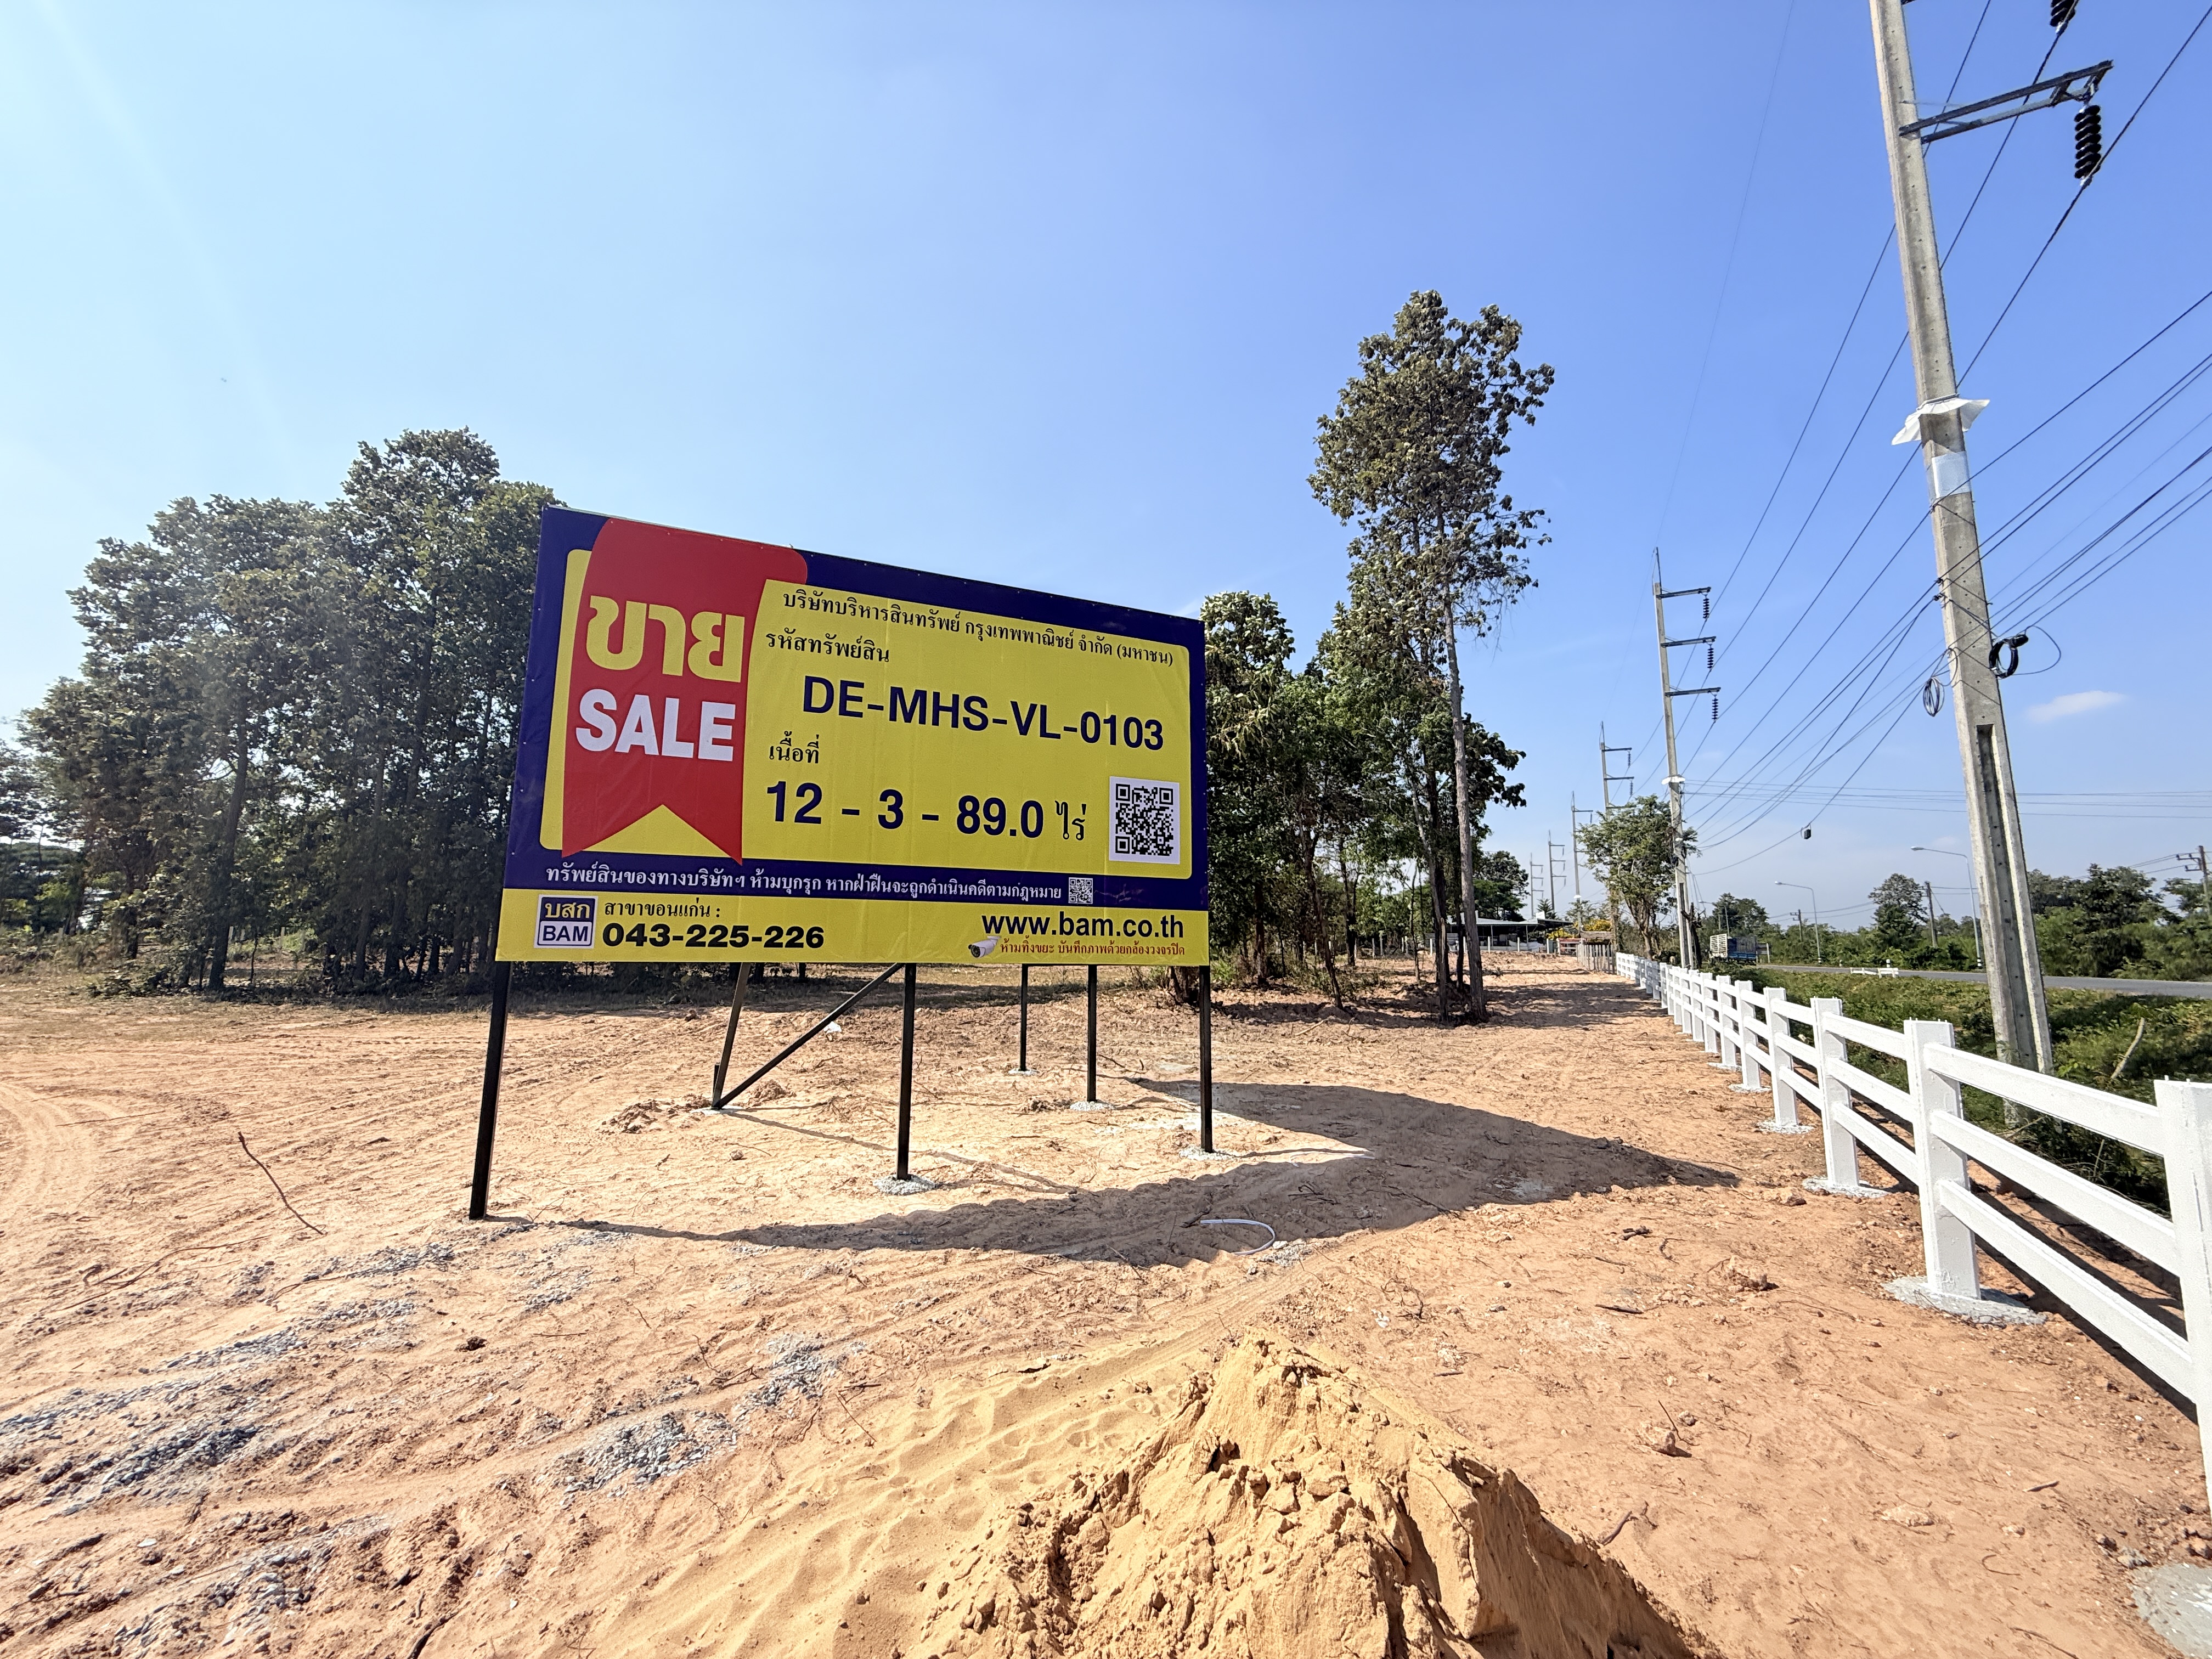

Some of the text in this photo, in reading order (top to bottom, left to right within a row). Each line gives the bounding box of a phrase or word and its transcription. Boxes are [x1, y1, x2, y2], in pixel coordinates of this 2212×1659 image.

[586, 595, 745, 683] ขาย
[783, 589, 1173, 667] บริษัทบริหารสินทรัพย์ กรุงเทพพาณิชย์ จำกัด (มหาชน)
[766, 627, 890, 663] รหัสทรัพย์สิน
[576, 689, 736, 761] SALE
[803, 675, 1164, 751] DE-MHS-VL-0103
[769, 731, 820, 764] เนื้อที่
[767, 781, 823, 825] 12
[878, 789, 904, 830] 3
[956, 795, 1044, 838] 89.0
[1054, 800, 1087, 841] ไร่
[546, 862, 745, 888] ทรัพย์สินของทางบริษัทฯ
[750, 869, 821, 894] ห้ามบุกรุก
[545, 902, 590, 918] บสก
[605, 898, 711, 918] สาขาขอนแก่น
[542, 923, 588, 942] BAM
[603, 923, 825, 949] 043-225-226
[981, 911, 1184, 938] www.bam.co.th
[1001, 935, 1184, 955] ห้ามทิ้งขยะ บันทึกภาพด้วยกล้องวงจรปิด
